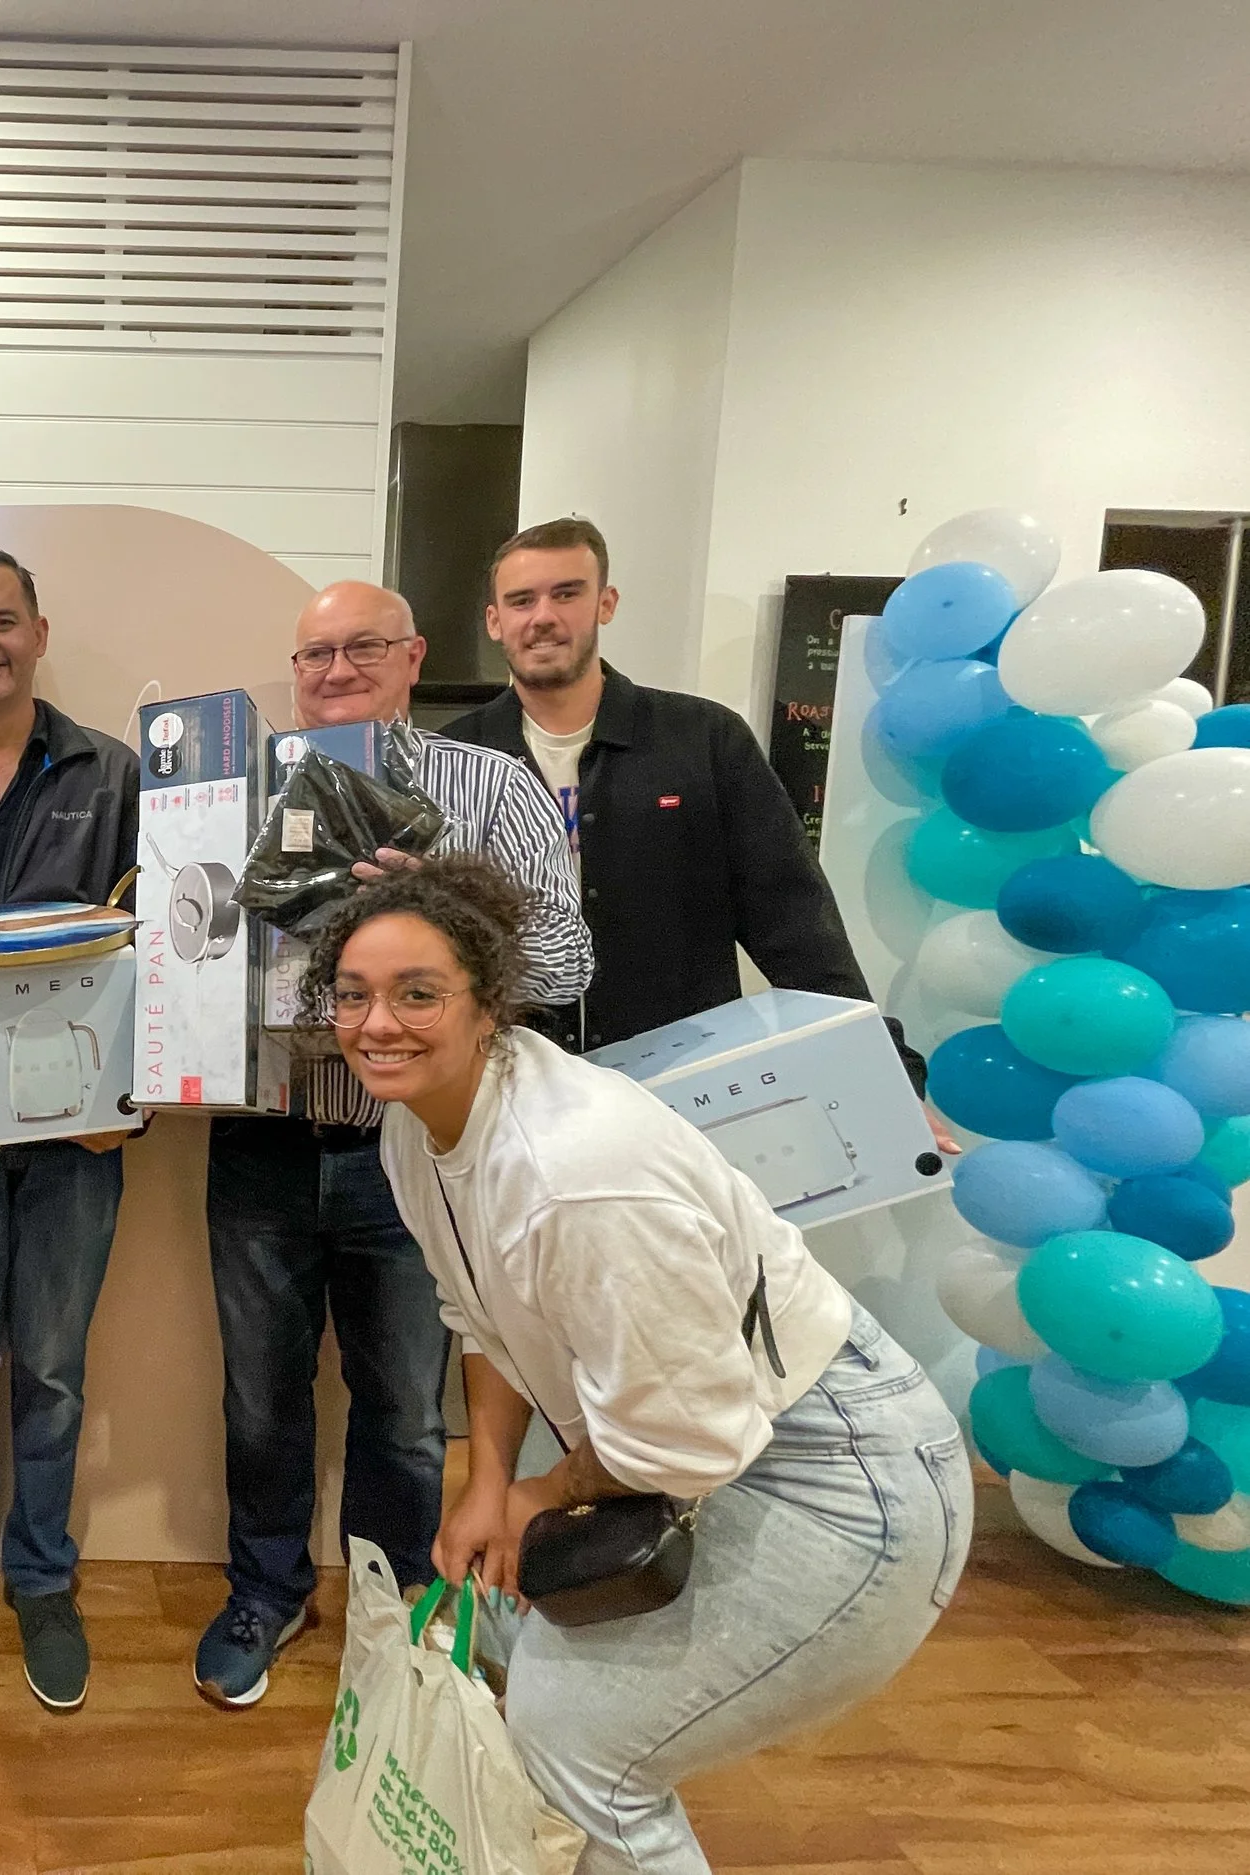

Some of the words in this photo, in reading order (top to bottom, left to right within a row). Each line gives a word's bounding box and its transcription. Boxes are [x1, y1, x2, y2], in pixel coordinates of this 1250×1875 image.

[786, 701, 834, 721] ROAS
[158, 749, 166, 774] Jamie
[163, 750, 173, 775] Oliver
[51, 810, 93, 820] NAUTICA
[149, 931, 164, 984] PAN
[276, 935, 290, 1018] SAUCEP
[145, 1004, 164, 1095] SAUTÉ
[429, 1829, 468, 1875] 80%
